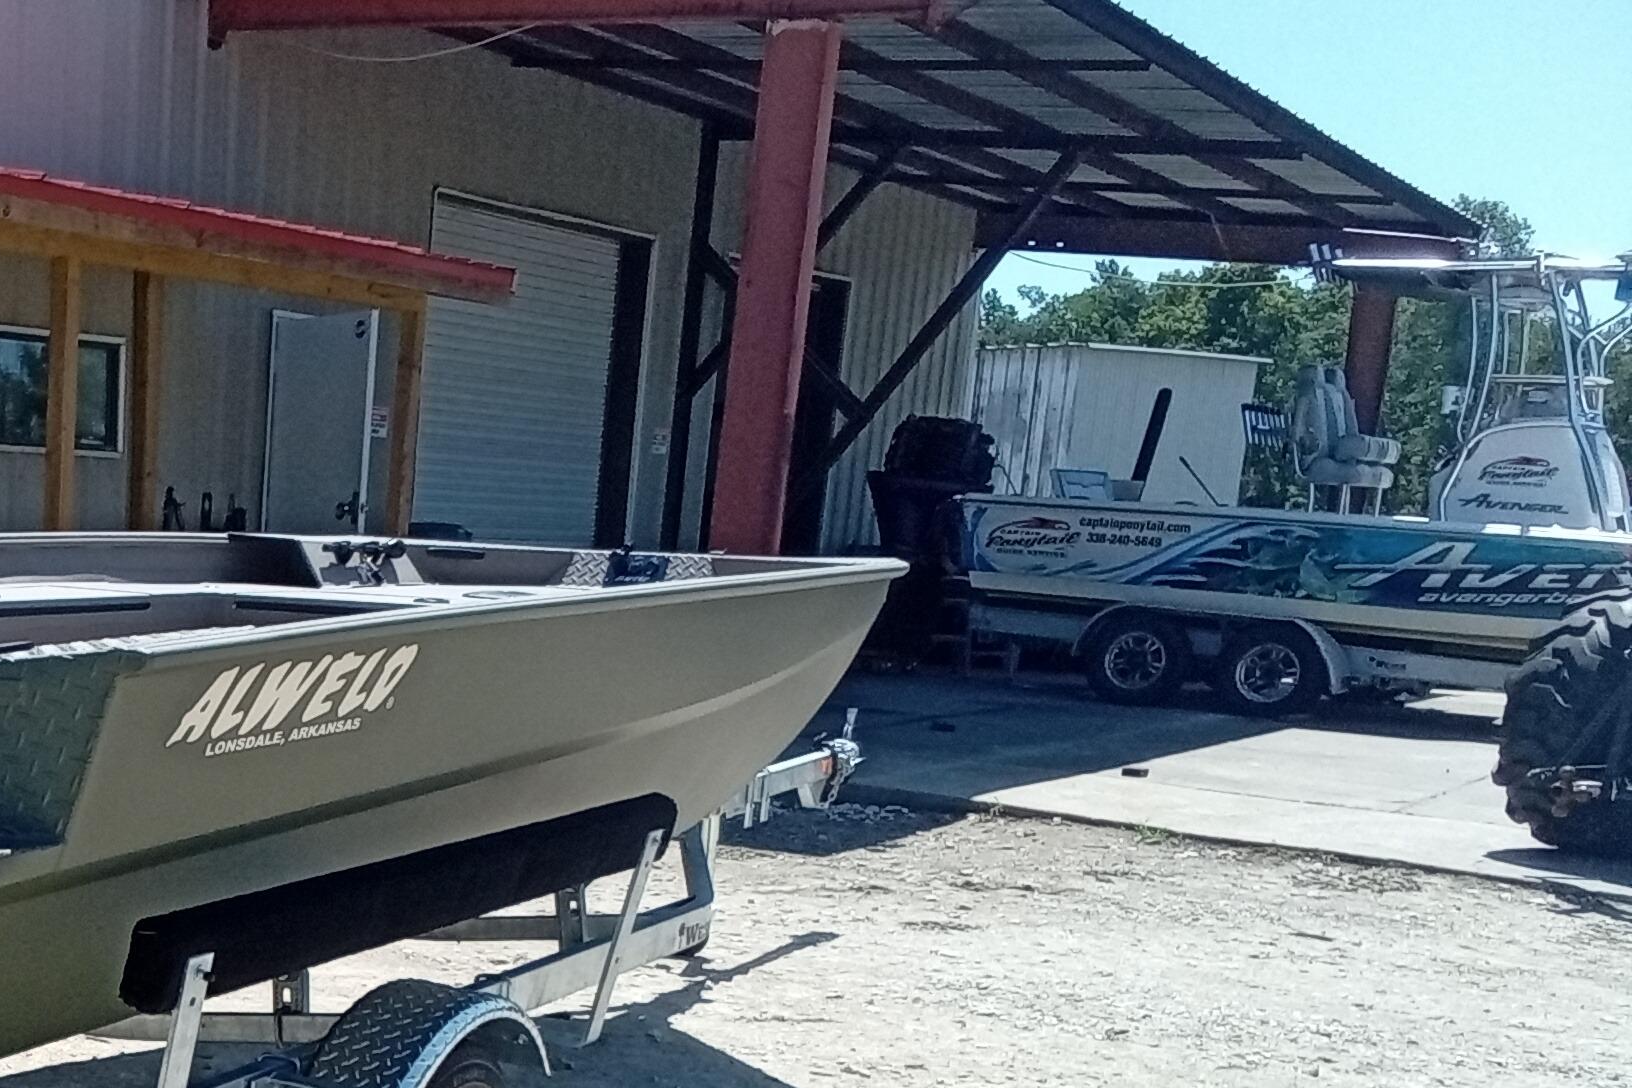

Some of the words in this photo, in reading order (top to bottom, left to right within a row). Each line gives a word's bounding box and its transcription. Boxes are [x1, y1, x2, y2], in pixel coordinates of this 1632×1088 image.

[165, 643, 419, 748] ALWELD
[204, 730, 285, 757] LONSDALE,
[288, 717, 362, 743] ARKANSAS
